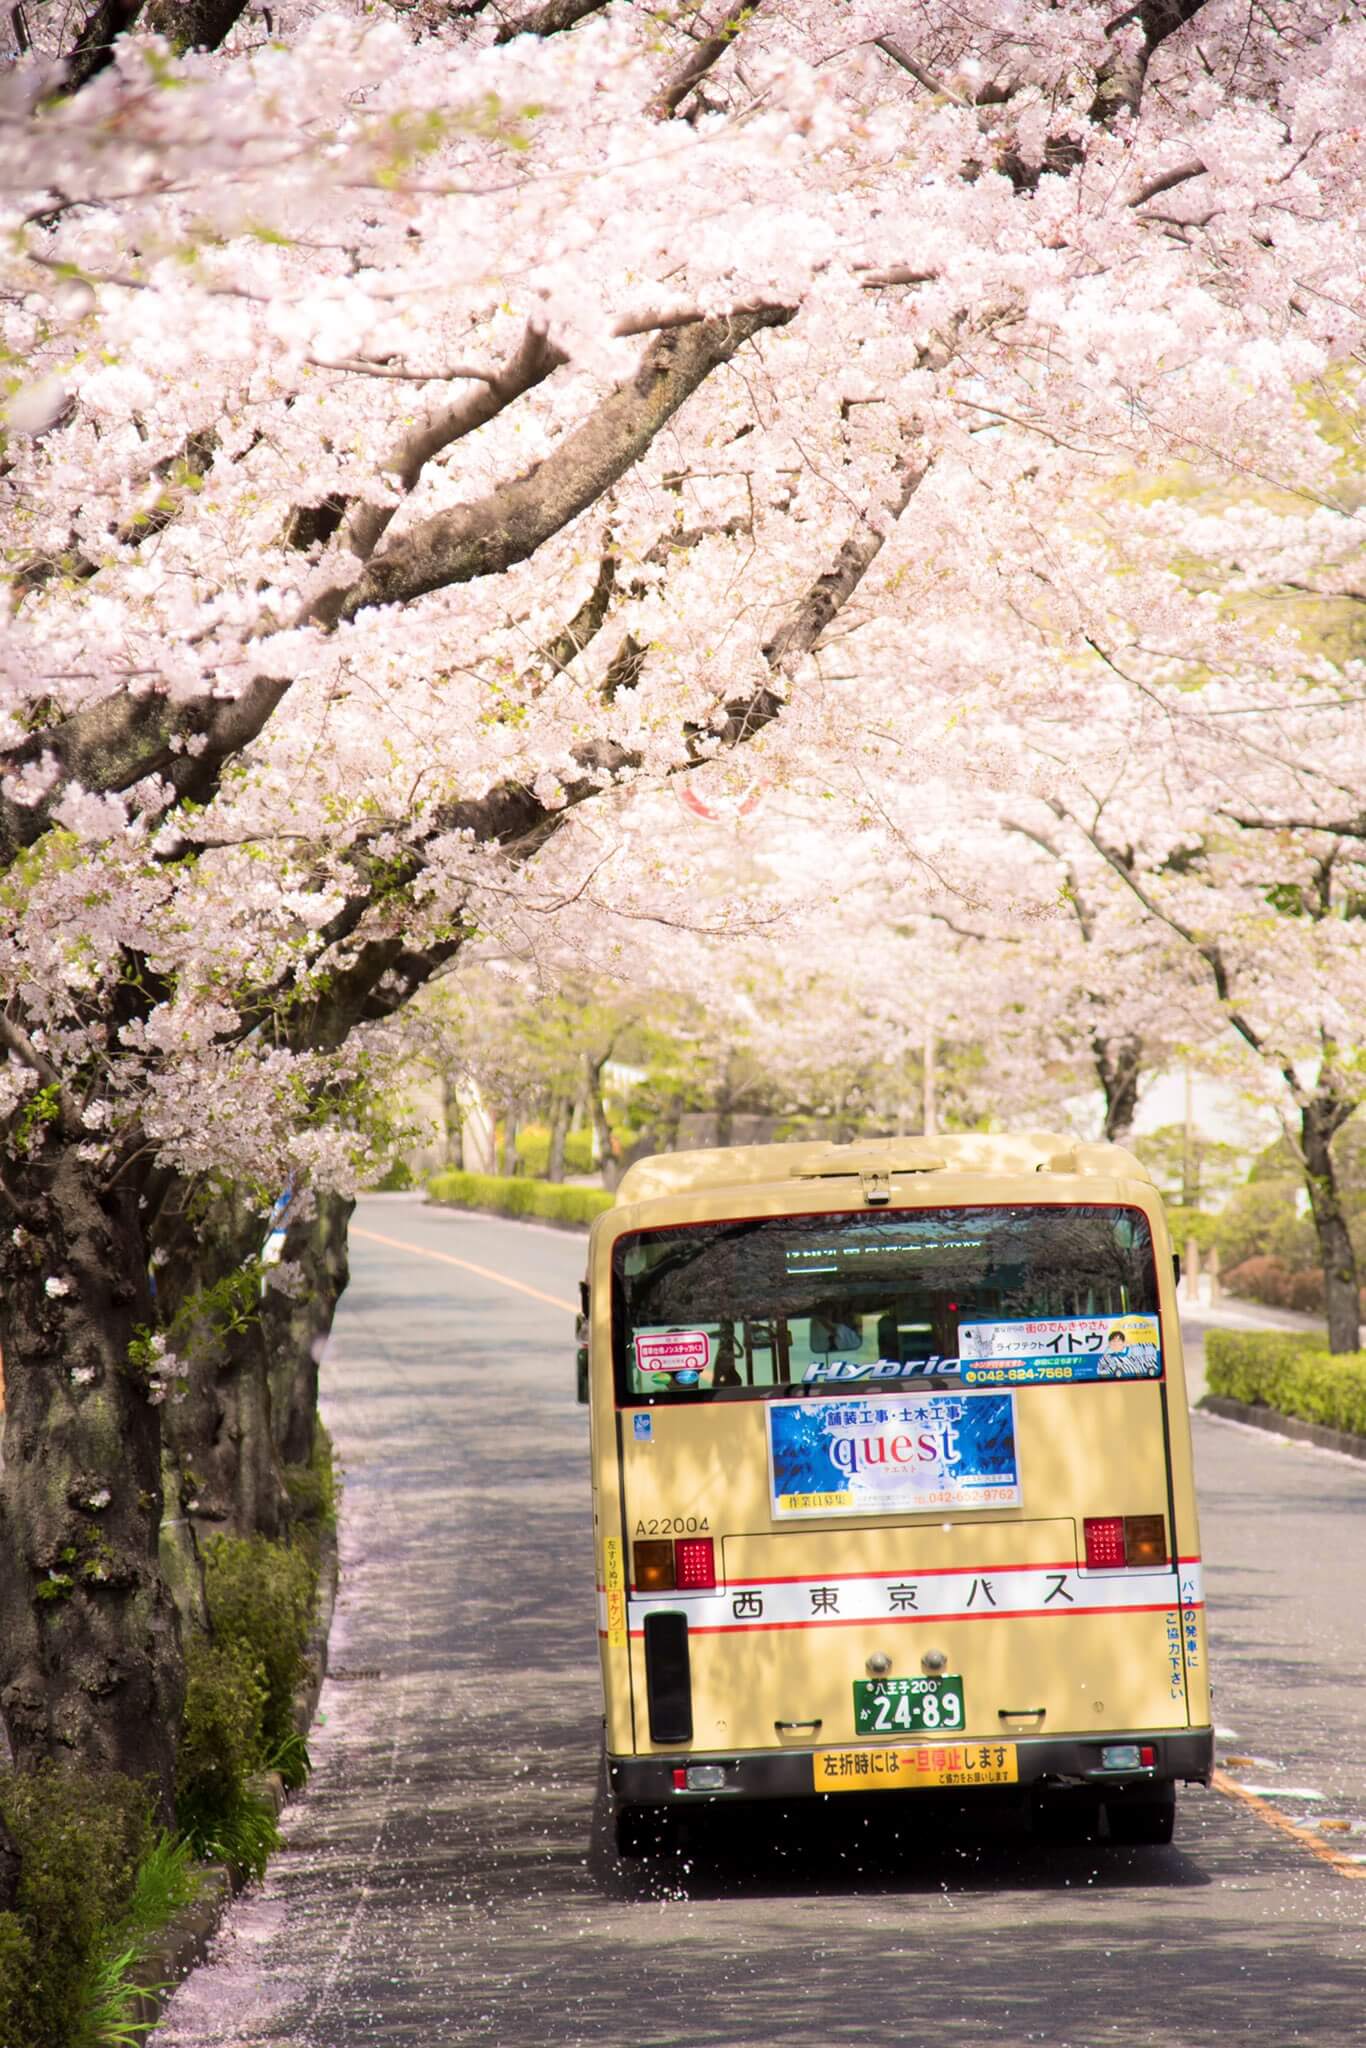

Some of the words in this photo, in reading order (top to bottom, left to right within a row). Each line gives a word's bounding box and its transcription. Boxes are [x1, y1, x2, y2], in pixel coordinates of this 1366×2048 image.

[1046, 1332, 1103, 1354] イトウ
[827, 1405, 961, 1426] 舗装工事・土木工事
[834, 1428, 957, 1472] quest
[636, 1517, 710, 1535] A22004
[732, 1575, 1074, 1619] 西東京バス
[1183, 1580, 1198, 1667] バスの発車に
[873, 1693, 961, 1730] 24-89
[824, 1747, 1007, 1776] 左折時には一旦停止します
